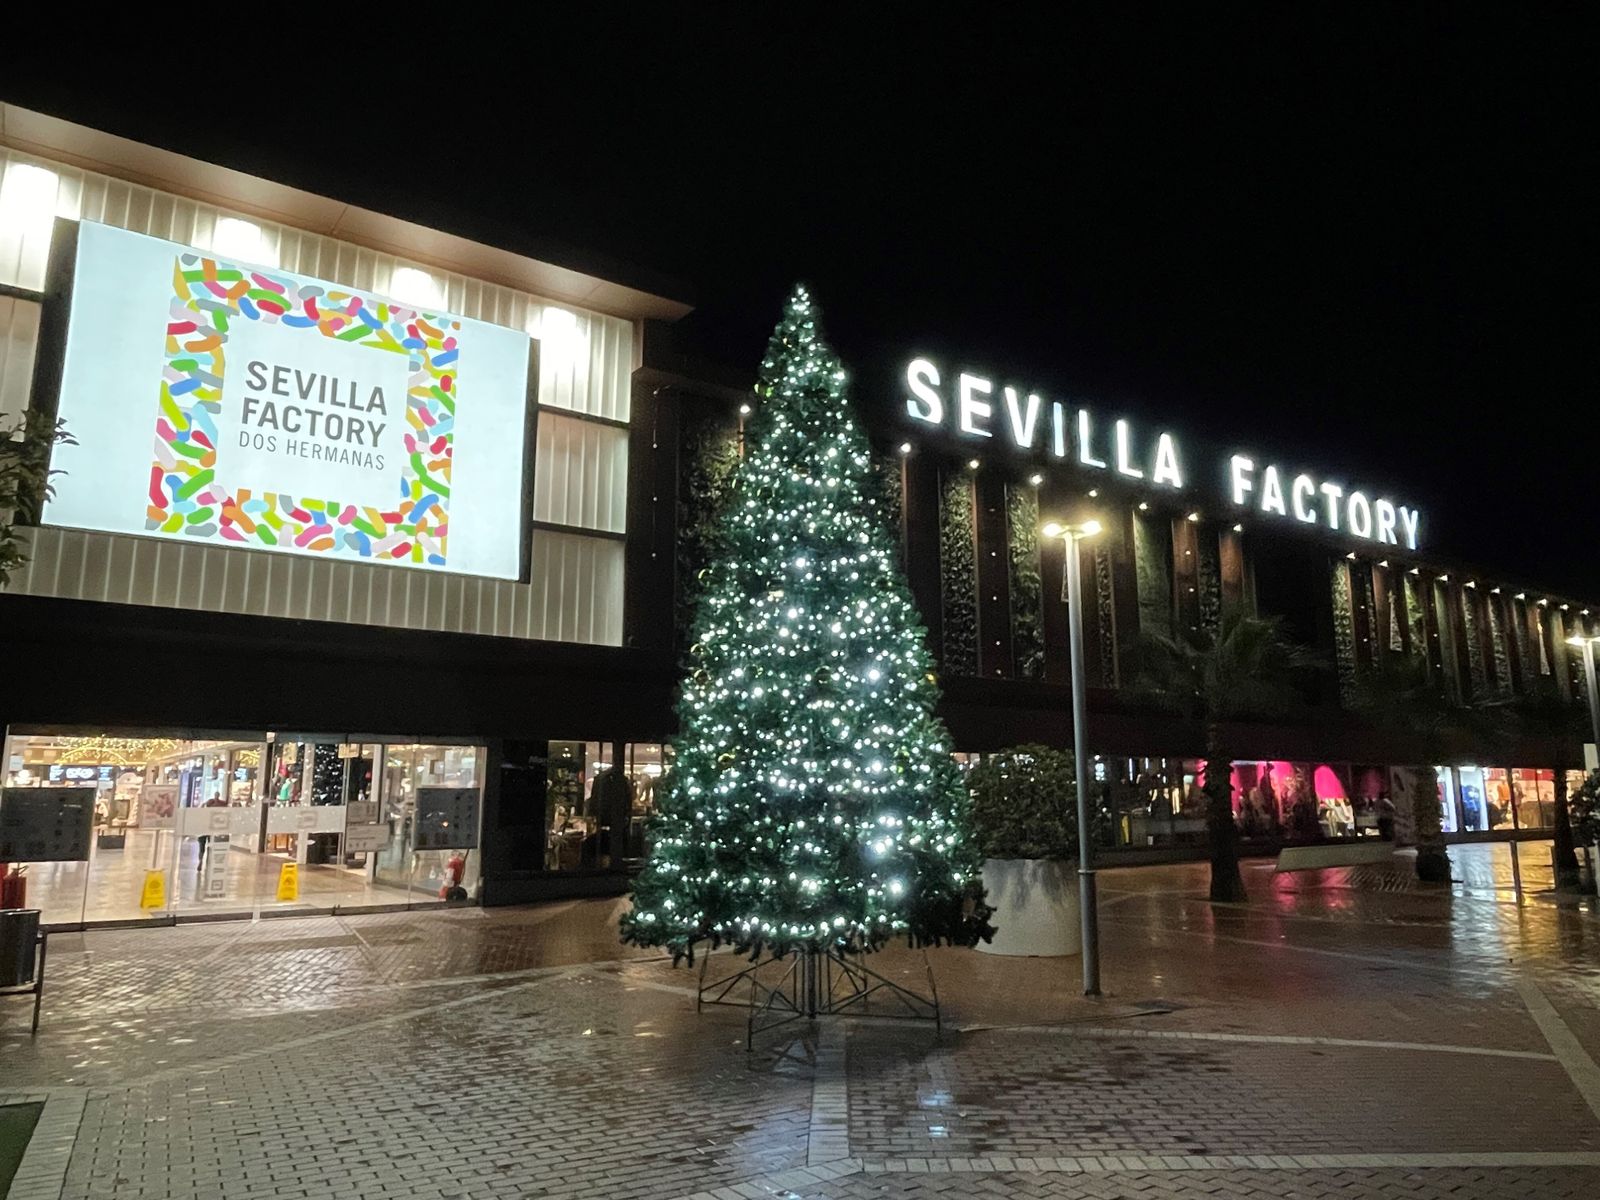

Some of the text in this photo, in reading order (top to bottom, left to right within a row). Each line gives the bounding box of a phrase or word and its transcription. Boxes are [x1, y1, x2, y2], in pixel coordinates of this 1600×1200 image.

[246, 361, 387, 416] SEVILLA
[241, 397, 386, 448] FACTORY
[239, 430, 385, 470] DOS HERMANAS
[906, 358, 1419, 550] SEVILLA FACTORY
